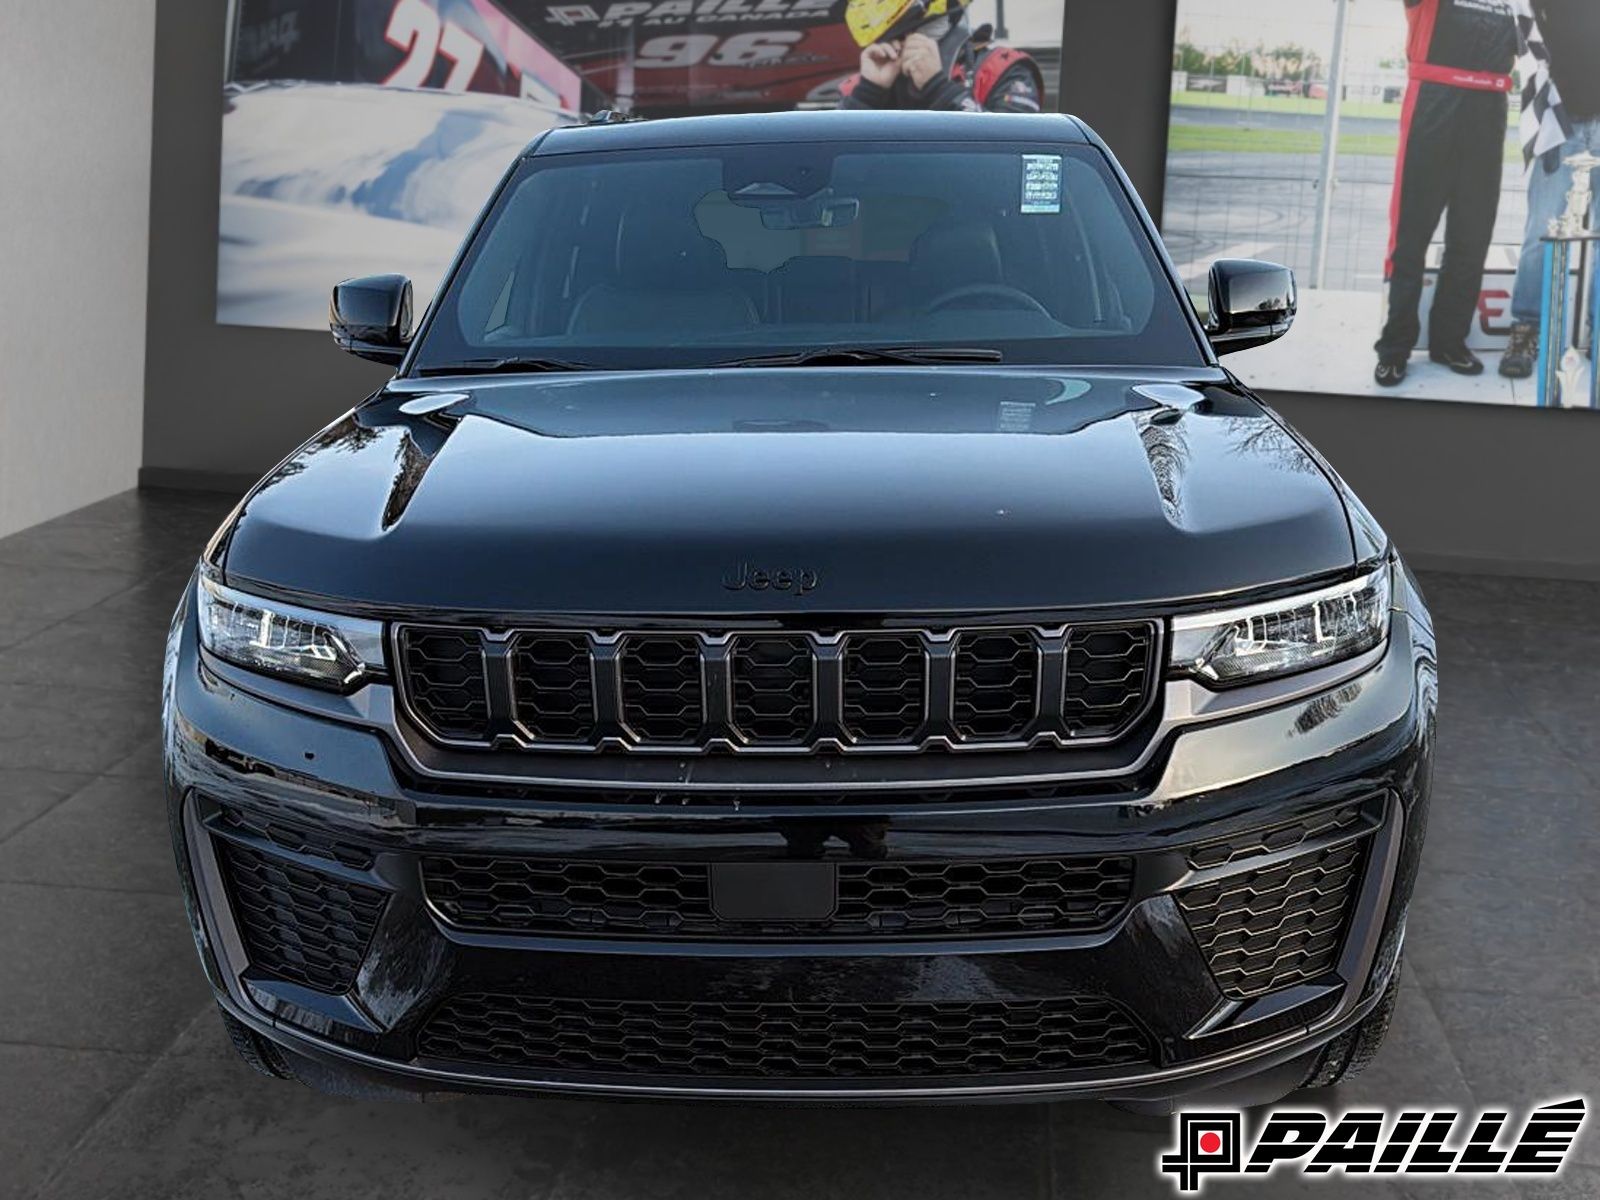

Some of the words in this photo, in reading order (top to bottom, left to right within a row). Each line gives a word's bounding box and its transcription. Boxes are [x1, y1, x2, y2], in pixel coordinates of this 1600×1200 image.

[641, 16, 686, 26] AU
[695, 9, 830, 23] CANADA
[380, 0, 484, 93] 27
[634, 30, 804, 69] 96
[721, 559, 819, 597] Jeep
